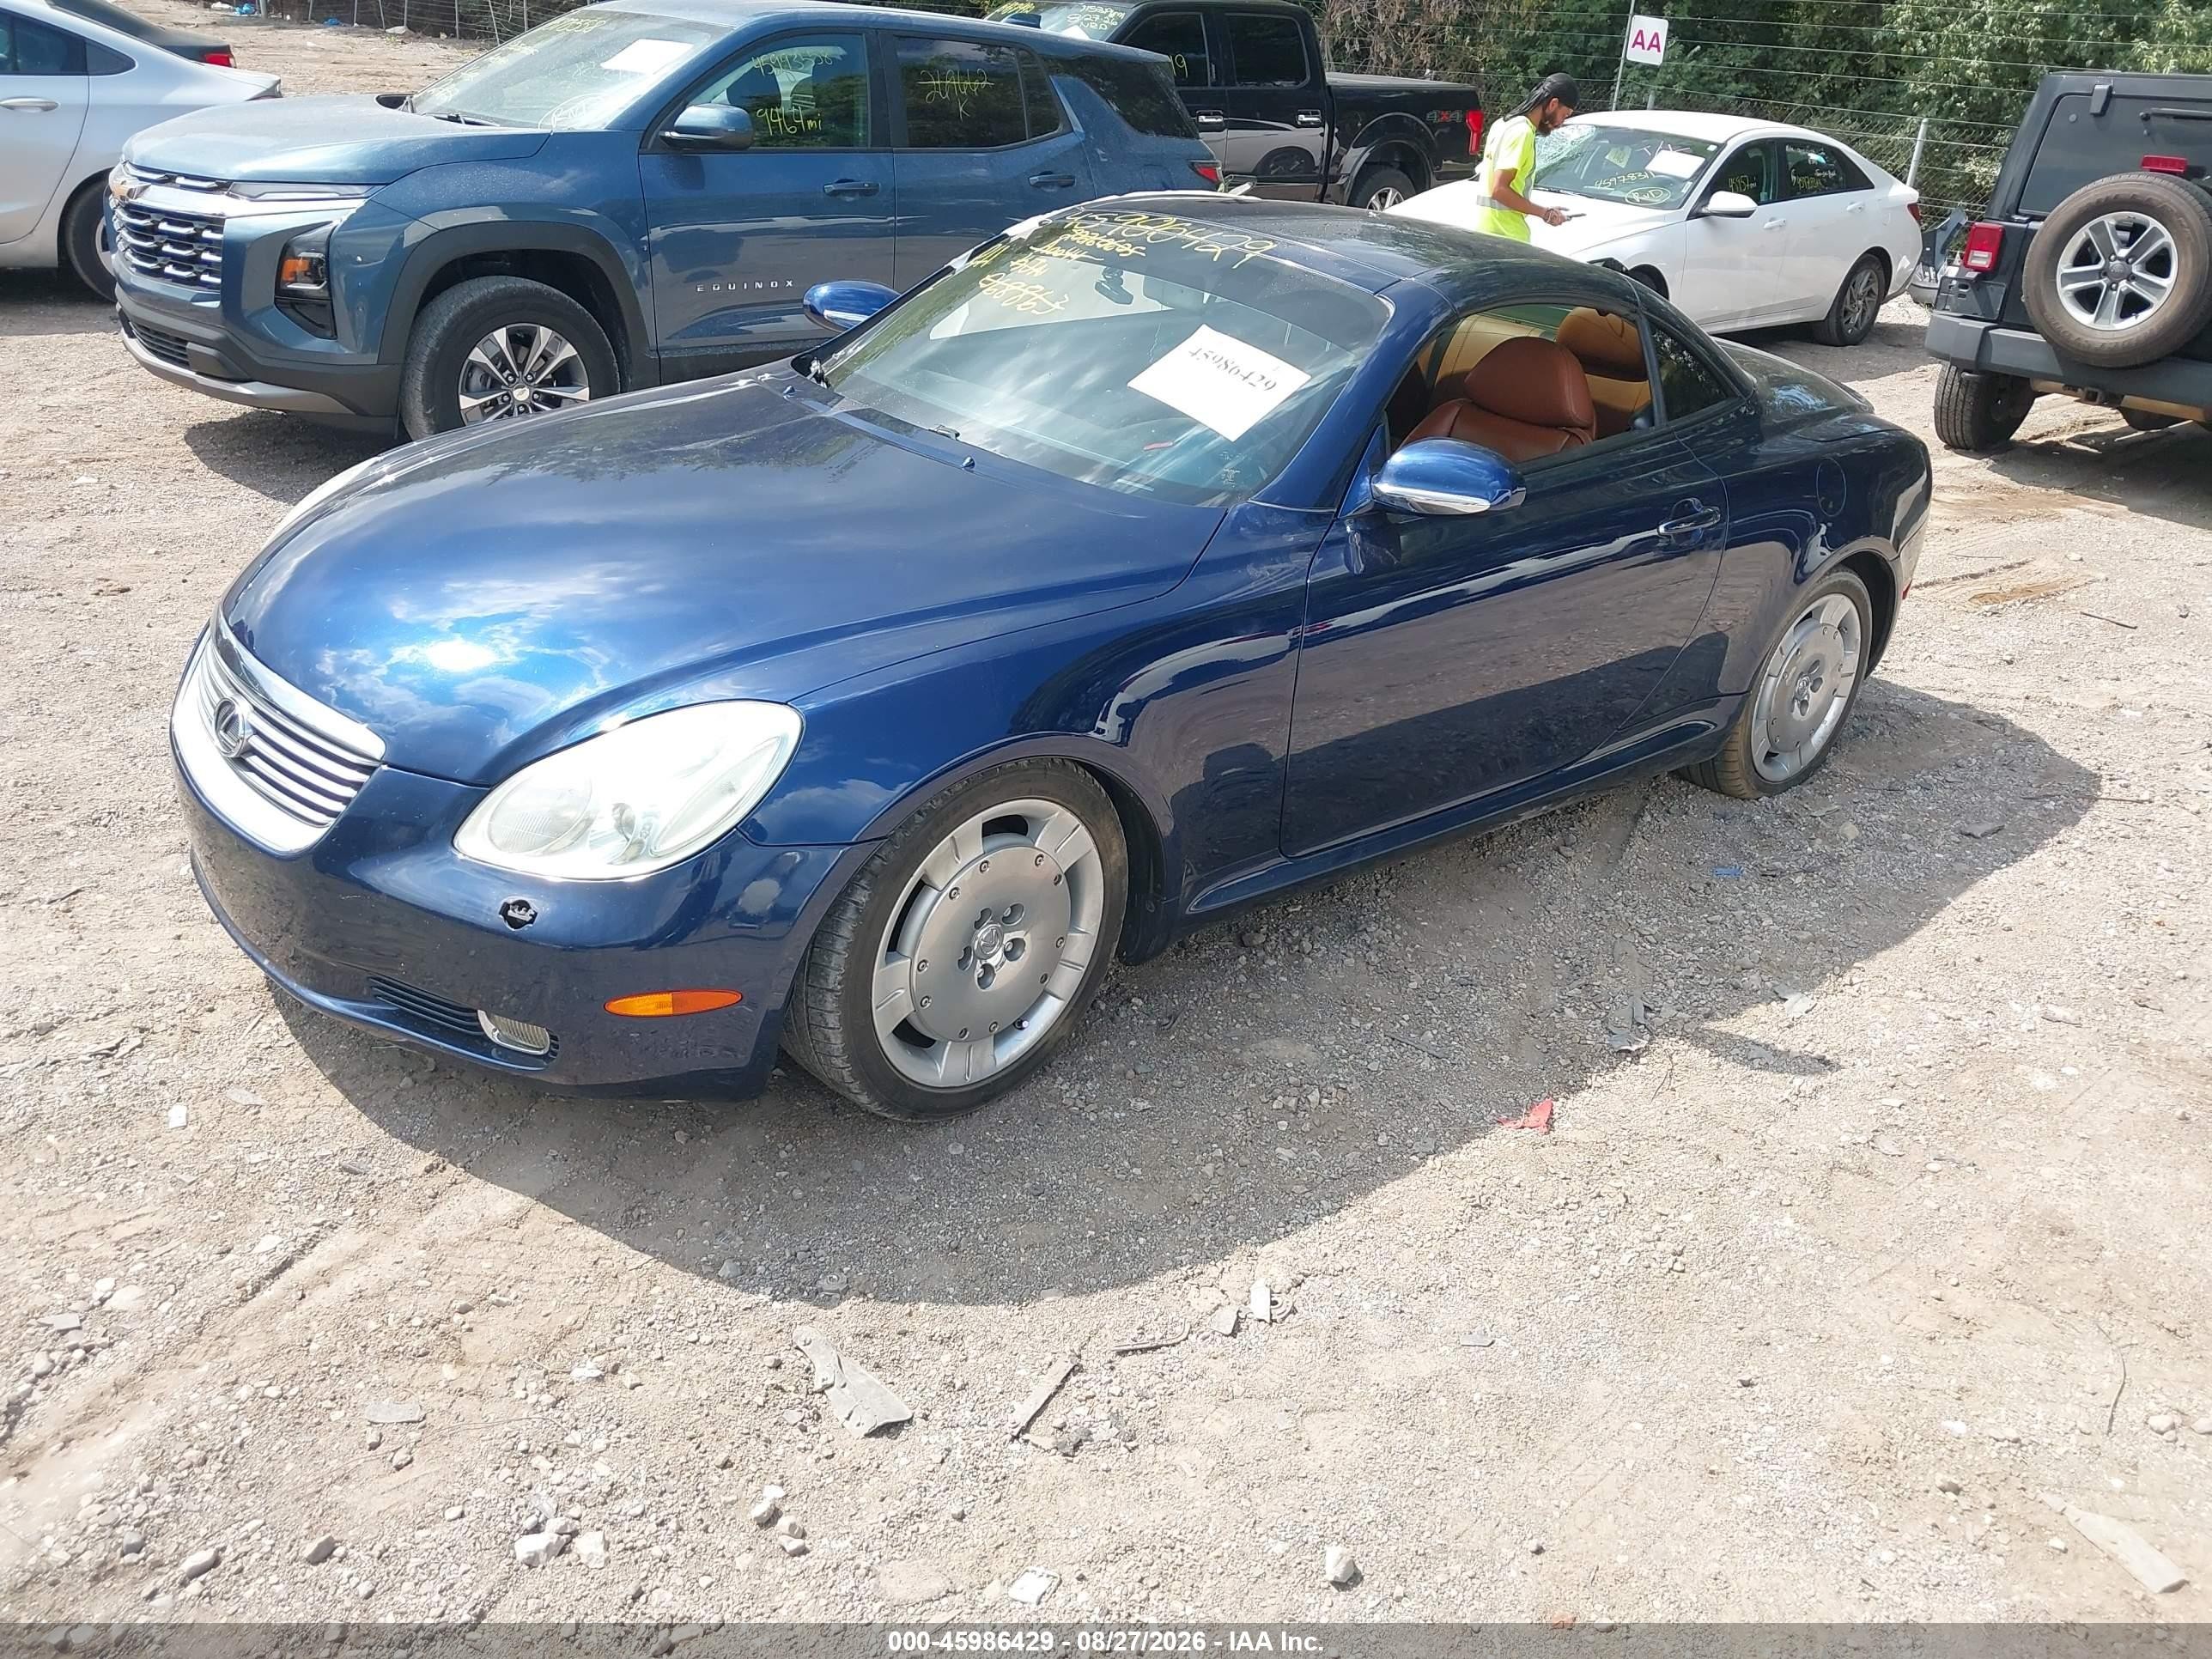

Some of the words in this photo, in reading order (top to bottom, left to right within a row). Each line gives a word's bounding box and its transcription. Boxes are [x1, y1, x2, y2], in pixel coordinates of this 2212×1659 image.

[1632, 29, 1661, 52] AA
[696, 280, 793, 292] EQUINOX
[1188, 347, 1278, 392] 45986429
